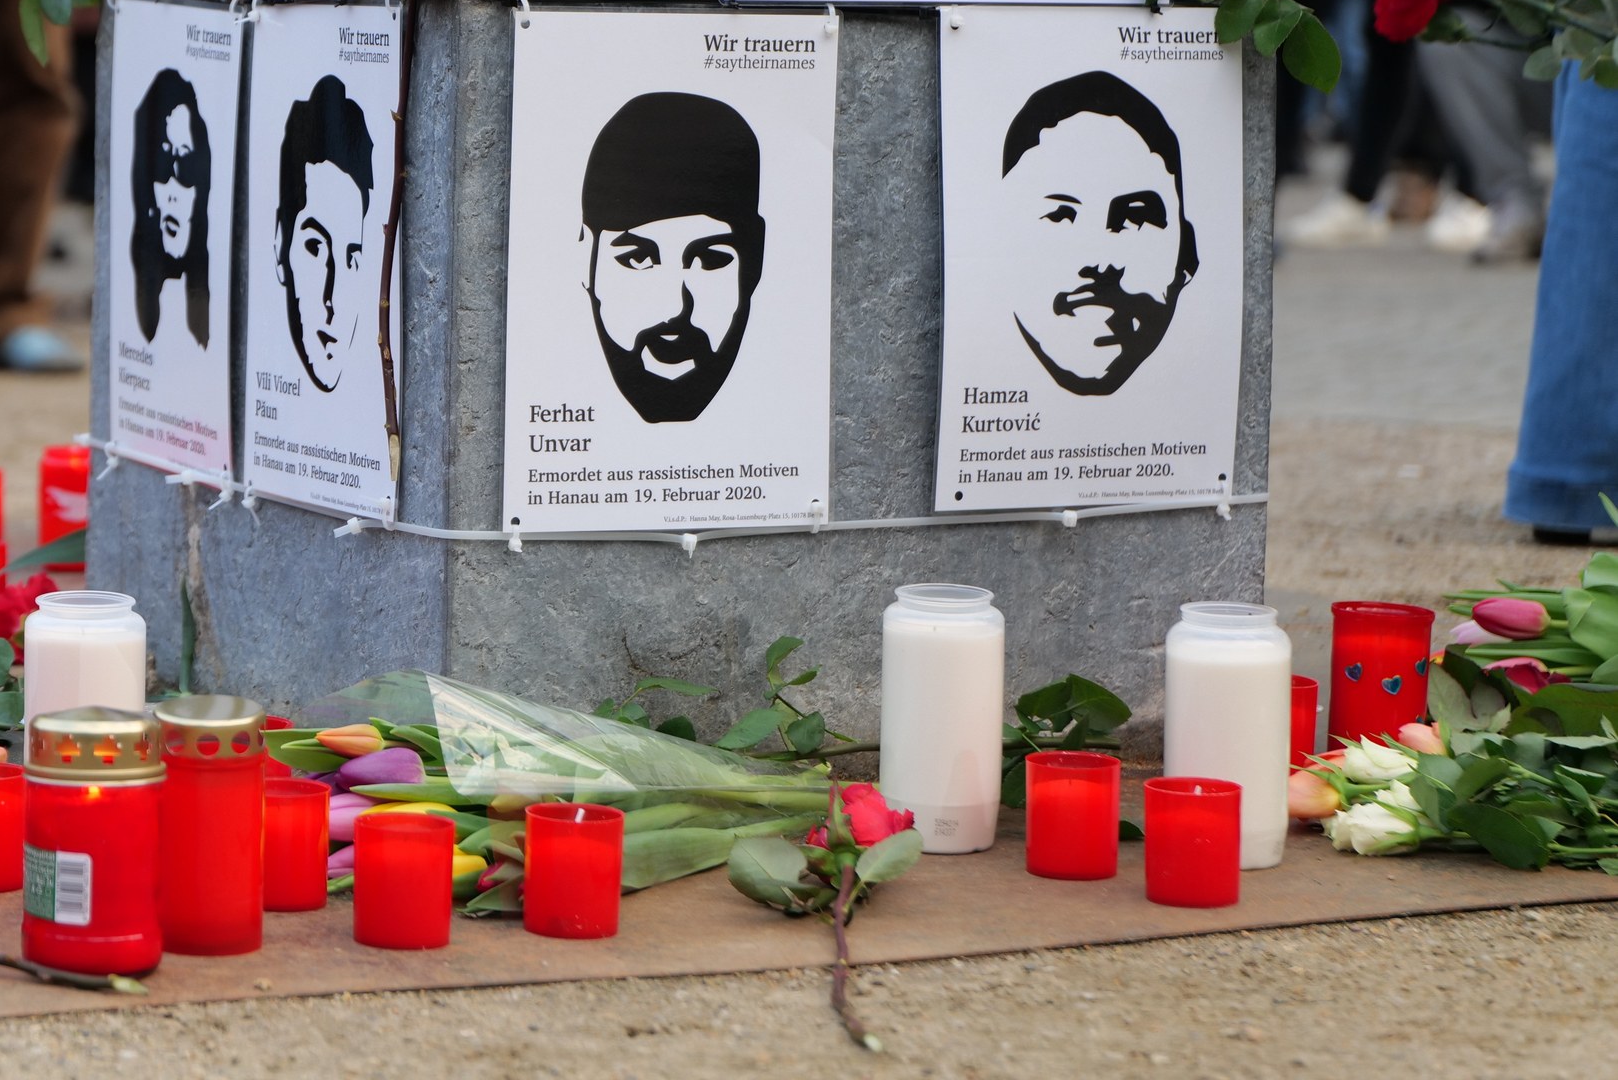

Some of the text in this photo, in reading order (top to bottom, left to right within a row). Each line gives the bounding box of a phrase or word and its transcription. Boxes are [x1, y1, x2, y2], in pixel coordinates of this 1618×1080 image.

[186, 25, 231, 45] Wir trauern
[339, 27, 389, 46] Wir trauern
[704, 34, 816, 52] Wir trauern
[1119, 27, 1150, 43] Wir
[186, 45, 230, 62] #saytheirnames
[339, 48, 389, 64] #saytheirnames
[704, 55, 815, 72] #saytheirnames
[1121, 46, 1224, 62] #saytheirnames
[119, 342, 153, 365] Mercedes
[119, 368, 150, 391] Kierpacz
[257, 372, 300, 396] Vili Viorel
[964, 388, 1028, 405] Hamza
[119, 396, 217, 440] Ermordet aus rassistischen Motiven
[529, 404, 595, 423] Ferhat
[962, 413, 1040, 433] Kurtović
[119, 417, 206, 456] in Hanau am 19. Februar 2020.
[529, 434, 591, 453] Unvar
[255, 432, 380, 470] Ermordet aus rassistischen Motiven
[960, 441, 1206, 462] Ermordet aus rassistischen Motiven
[254, 452, 361, 488] in Hanau am 19. Februar 2020.
[528, 463, 799, 483] Ermordet aus rassistischen Motiven
[959, 463, 1174, 483] in Hanau am 19. Februar 2020.
[528, 486, 766, 505] in Hanau am 19. Februar 2020.
